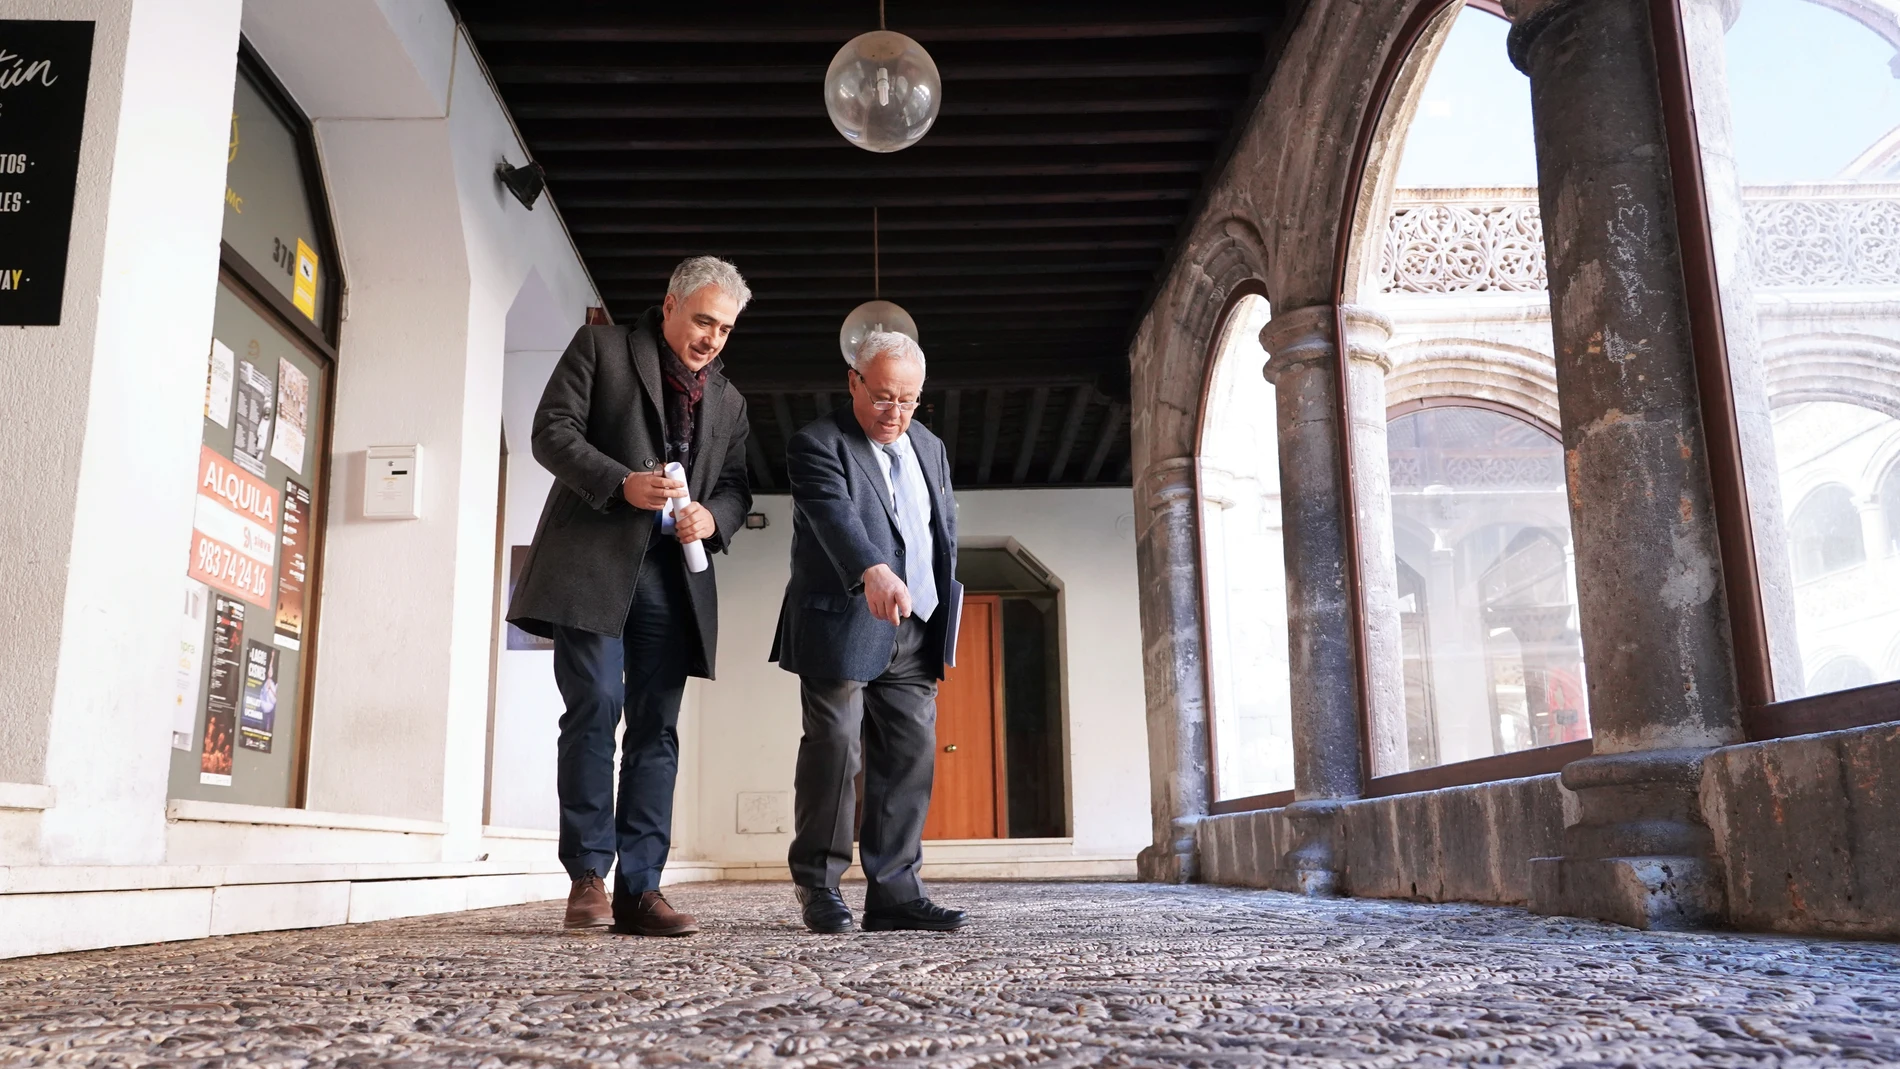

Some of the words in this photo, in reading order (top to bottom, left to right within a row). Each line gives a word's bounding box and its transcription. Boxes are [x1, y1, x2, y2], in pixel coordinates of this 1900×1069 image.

[203, 460, 274, 524] ALQUILA
[198, 537, 221, 577] 983
[221, 549, 238, 584] 74
[237, 556, 253, 590] 24
[252, 564, 267, 597] 16
